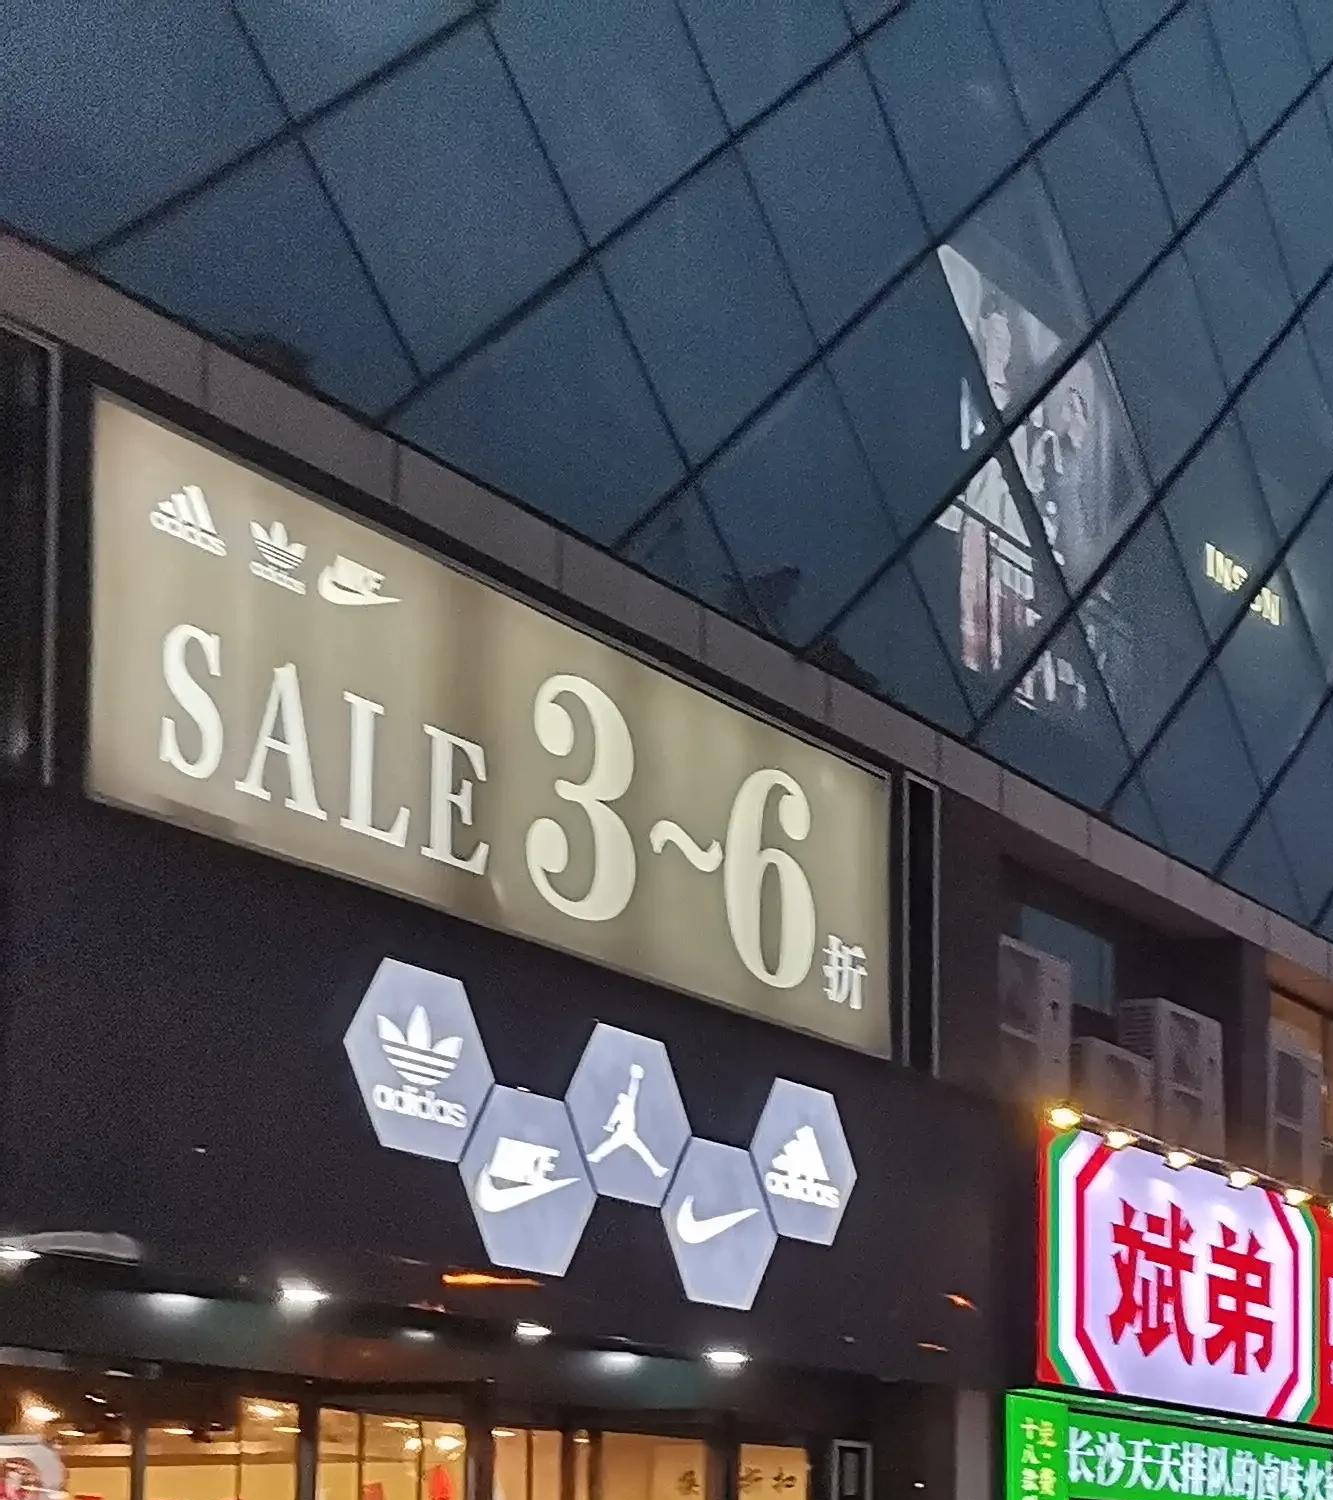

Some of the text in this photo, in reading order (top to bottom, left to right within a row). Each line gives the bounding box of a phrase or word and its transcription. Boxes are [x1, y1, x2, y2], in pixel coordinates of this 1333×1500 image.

[158, 623, 491, 877] SALE
[373, 1083, 468, 1130] adidas
[1108, 1198, 1275, 1375] 斌弟
